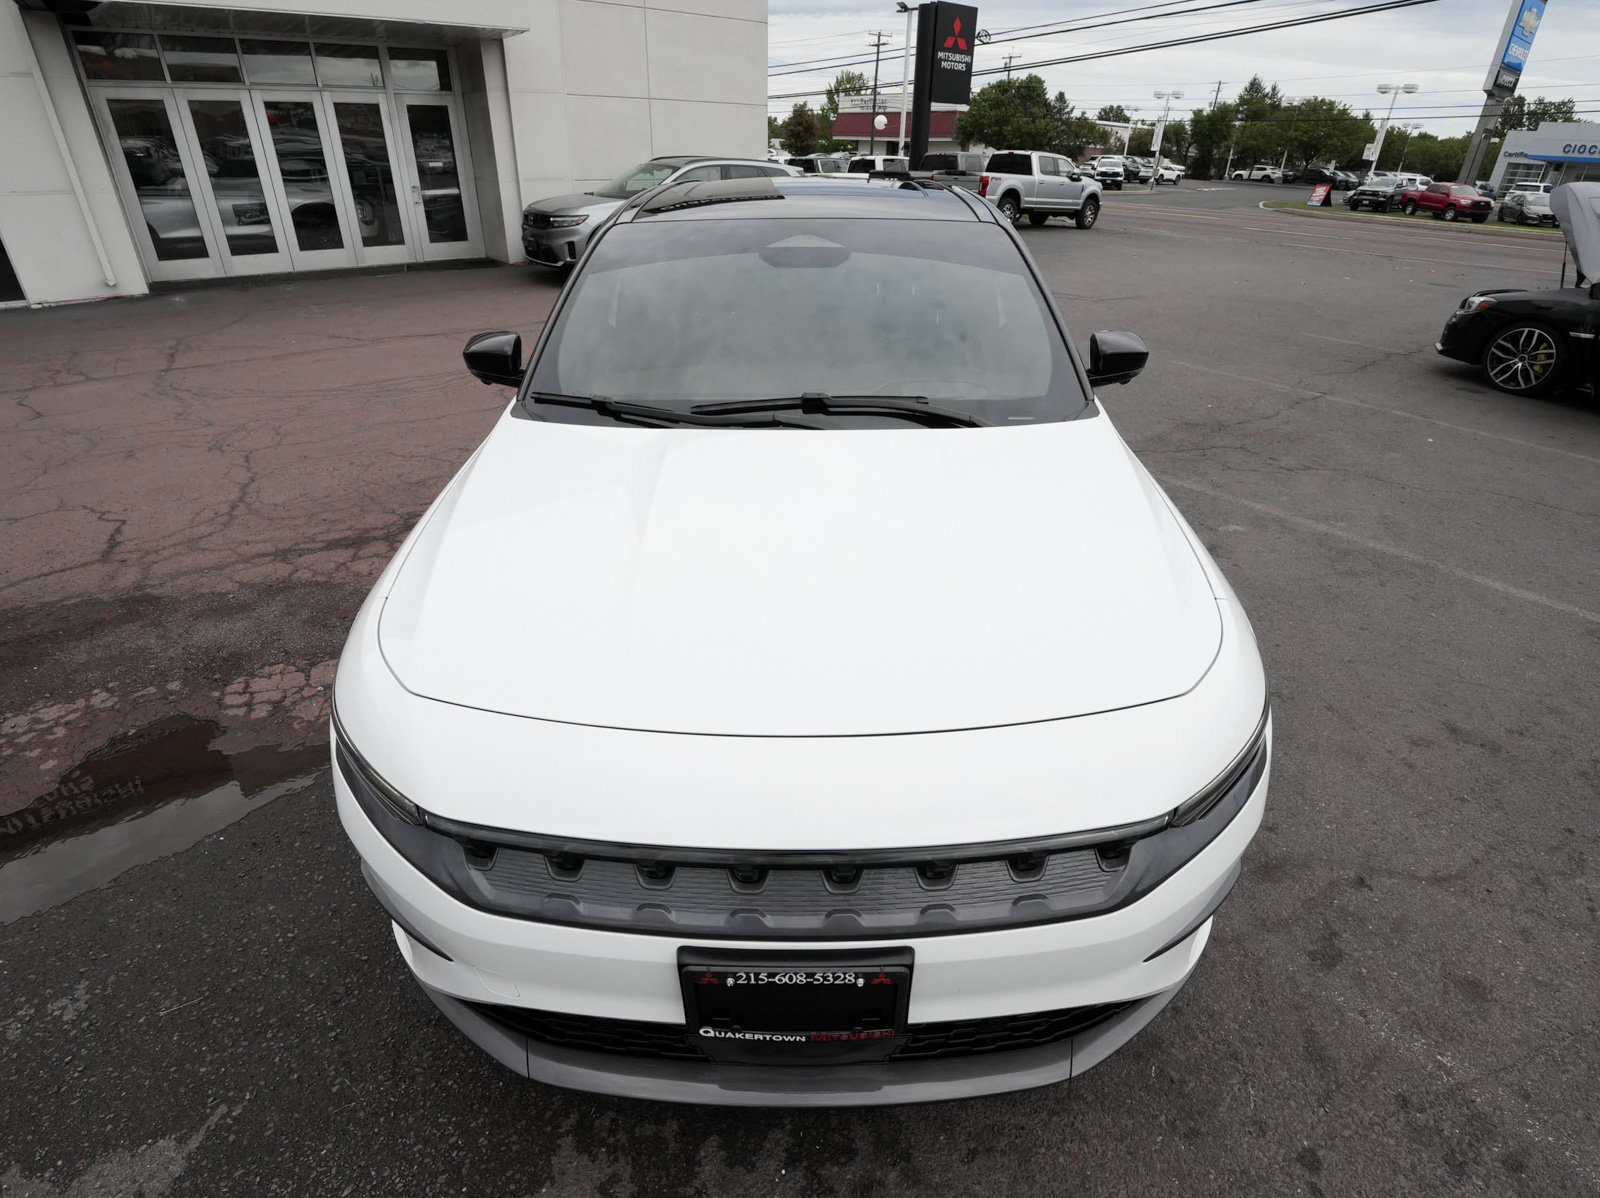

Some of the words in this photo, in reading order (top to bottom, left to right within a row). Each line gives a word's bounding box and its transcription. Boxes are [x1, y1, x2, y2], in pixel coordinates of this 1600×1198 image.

[937, 51, 971, 63] MITSUBISHI
[941, 60, 966, 71] MOTORS
[1562, 143, 1600, 155] CIOC
[735, 972, 856, 985] 215-608-5328
